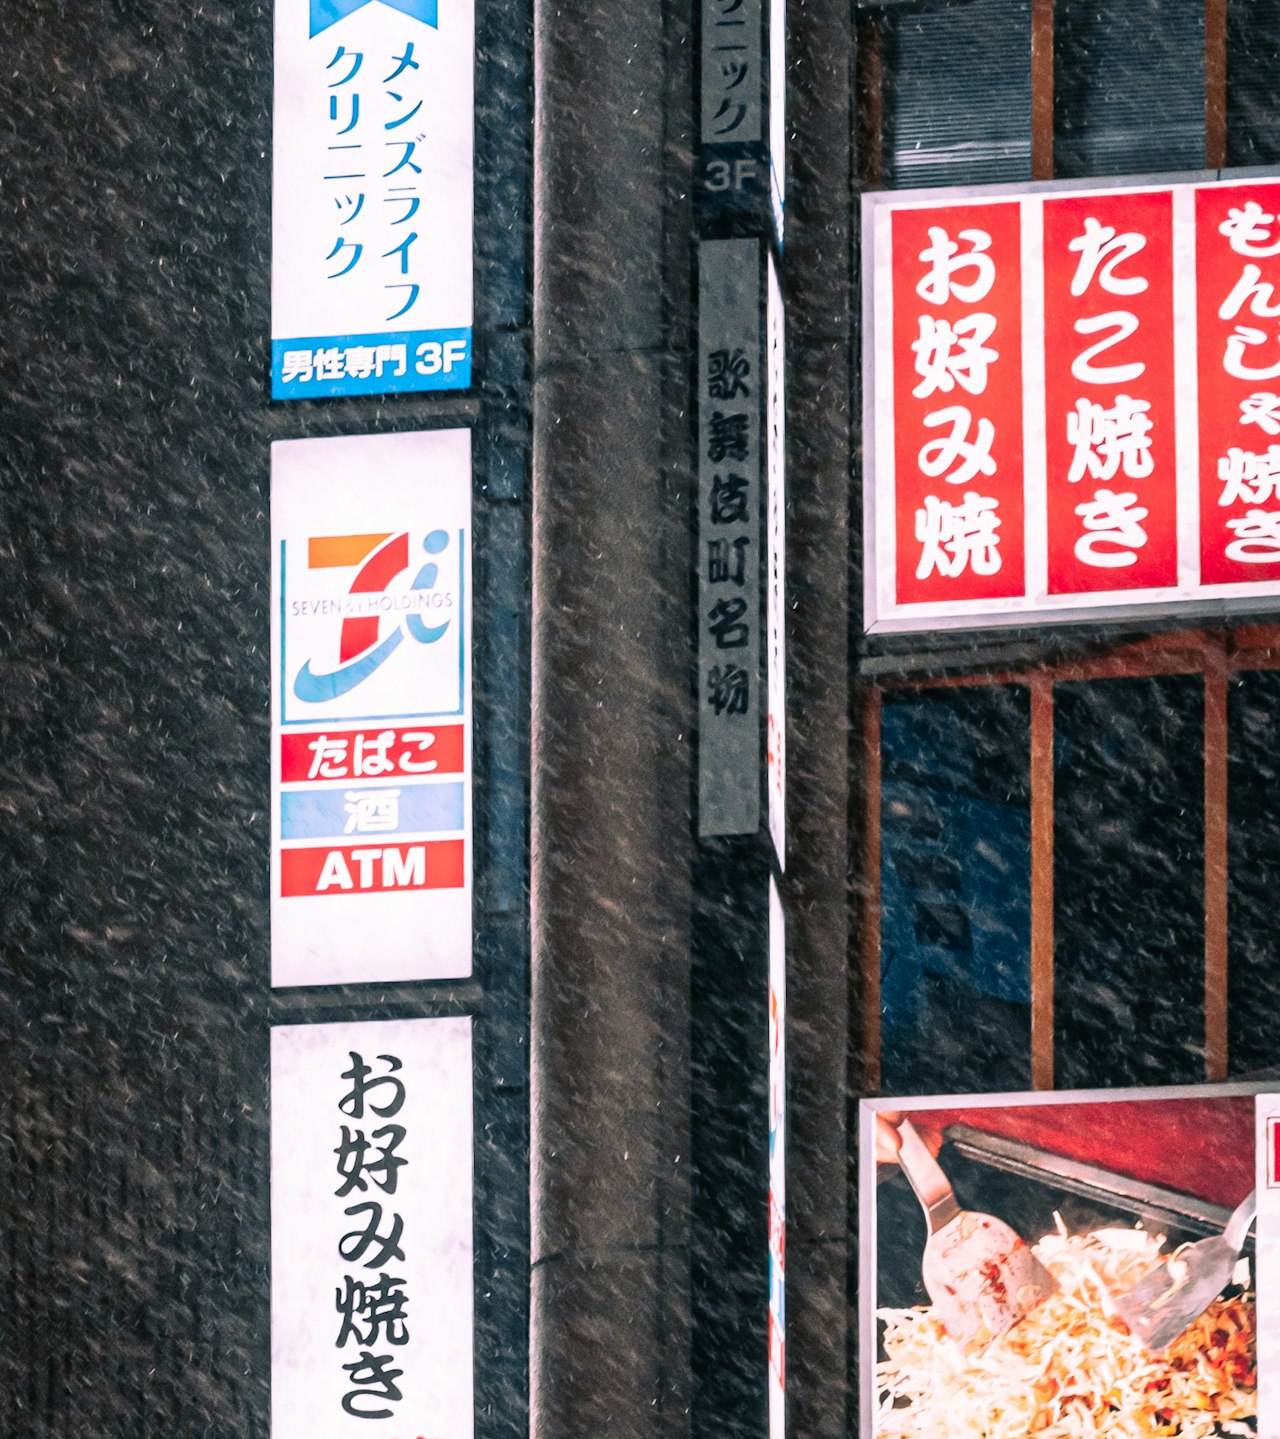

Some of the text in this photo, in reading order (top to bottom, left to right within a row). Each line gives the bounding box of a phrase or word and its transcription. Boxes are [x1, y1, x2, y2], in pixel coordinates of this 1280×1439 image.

[324, 45, 366, 280] クリニック
[381, 41, 424, 322] メンズライフ
[704, 160, 759, 193] 3F
[281, 339, 466, 382] 男性専門 3F
[911, 226, 1003, 581] お好み焼
[1067, 216, 1155, 569] たこ焼き
[368, 592, 453, 612] HOLDINGS
[707, 348, 751, 718] 歌舞伎町名物
[308, 730, 438, 779] たばこ
[343, 789, 401, 834] 酒
[316, 846, 426, 891] ATM
[333, 1051, 410, 1419] お好み焼き
